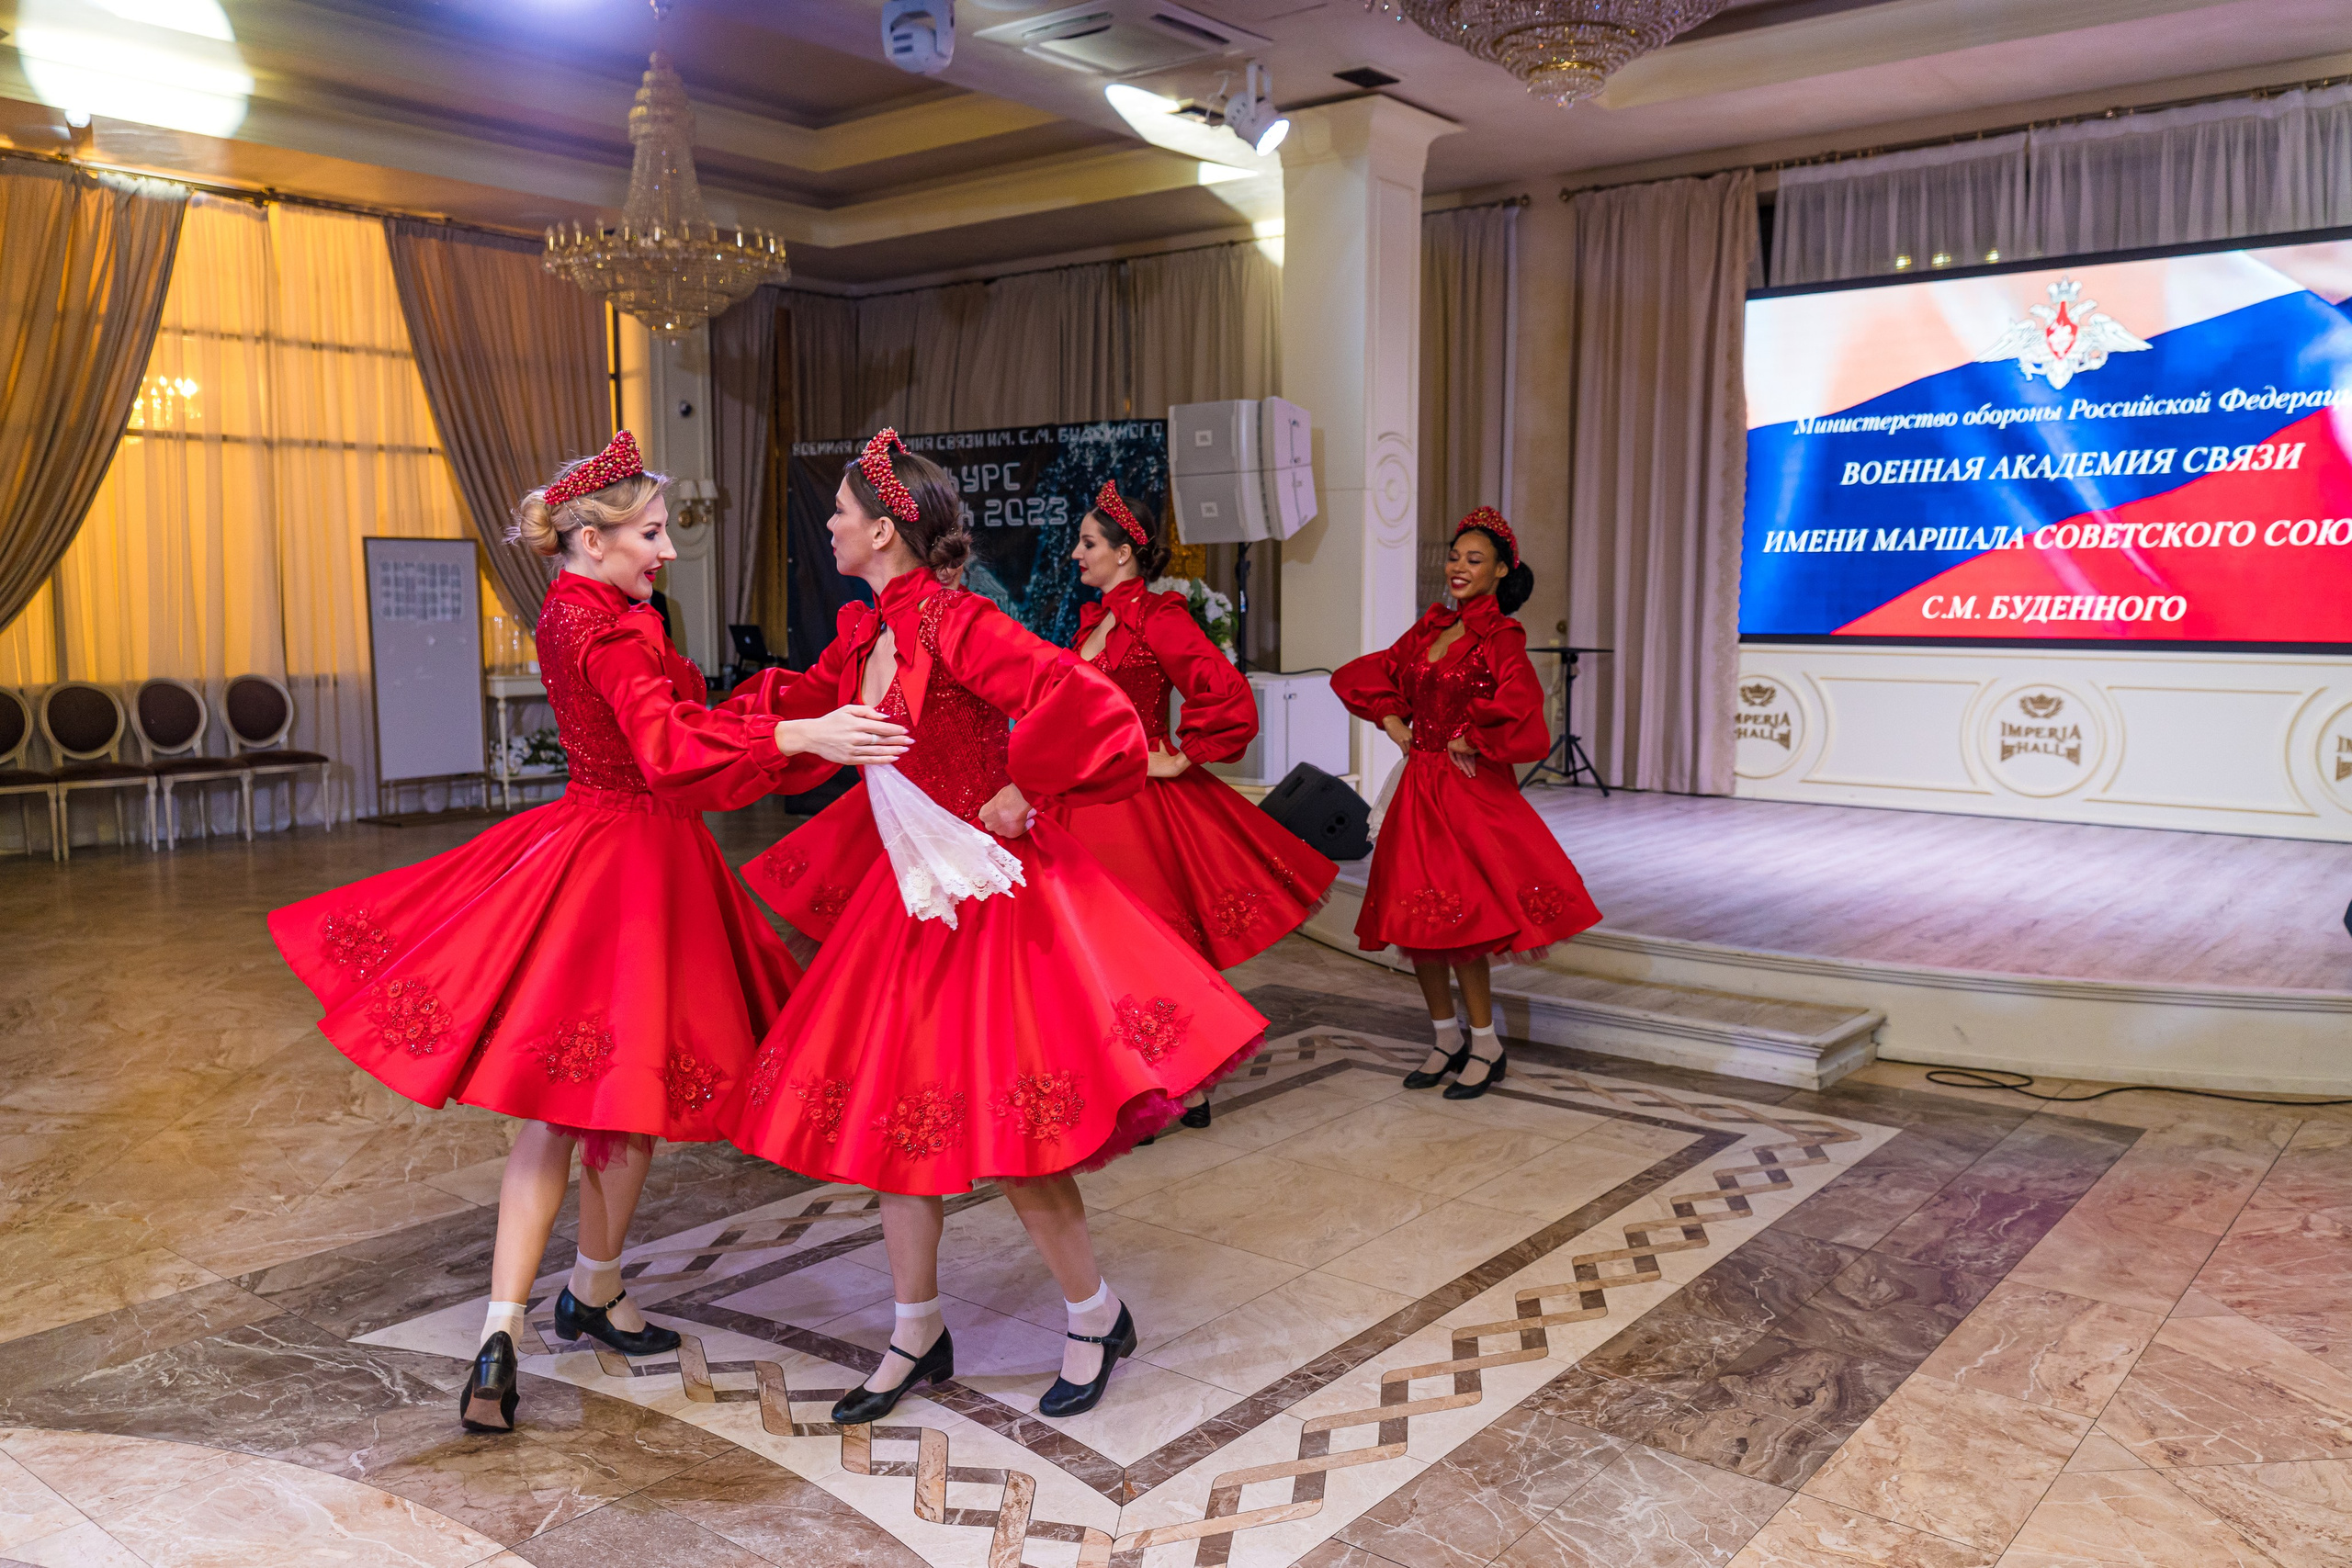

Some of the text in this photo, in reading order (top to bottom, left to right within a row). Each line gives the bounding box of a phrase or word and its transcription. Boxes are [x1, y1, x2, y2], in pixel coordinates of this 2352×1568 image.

[1792, 412, 1959, 435] Министерство
[1962, 402, 2064, 430] обороны
[2067, 390, 2212, 421] Российской
[792, 439, 853, 457] ВОЕННАЯ
[936, 434, 985, 450] СВЯЗИ
[988, 432, 1015, 447] ИМ.
[1018, 428, 1054, 445] С.М.
[1839, 442, 2307, 485] ВОЕННАЯ АКАДЕМИЯ СВЯЗИ
[984, 497, 1069, 527] 2023
[1763, 527, 1869, 553] ИМЕНИ
[1871, 525, 2025, 552] МАРШАЛА
[2032, 519, 2257, 549] СОВЕТСКОГО
[1921, 595, 2188, 624] С.М. БУДЕННОГО
